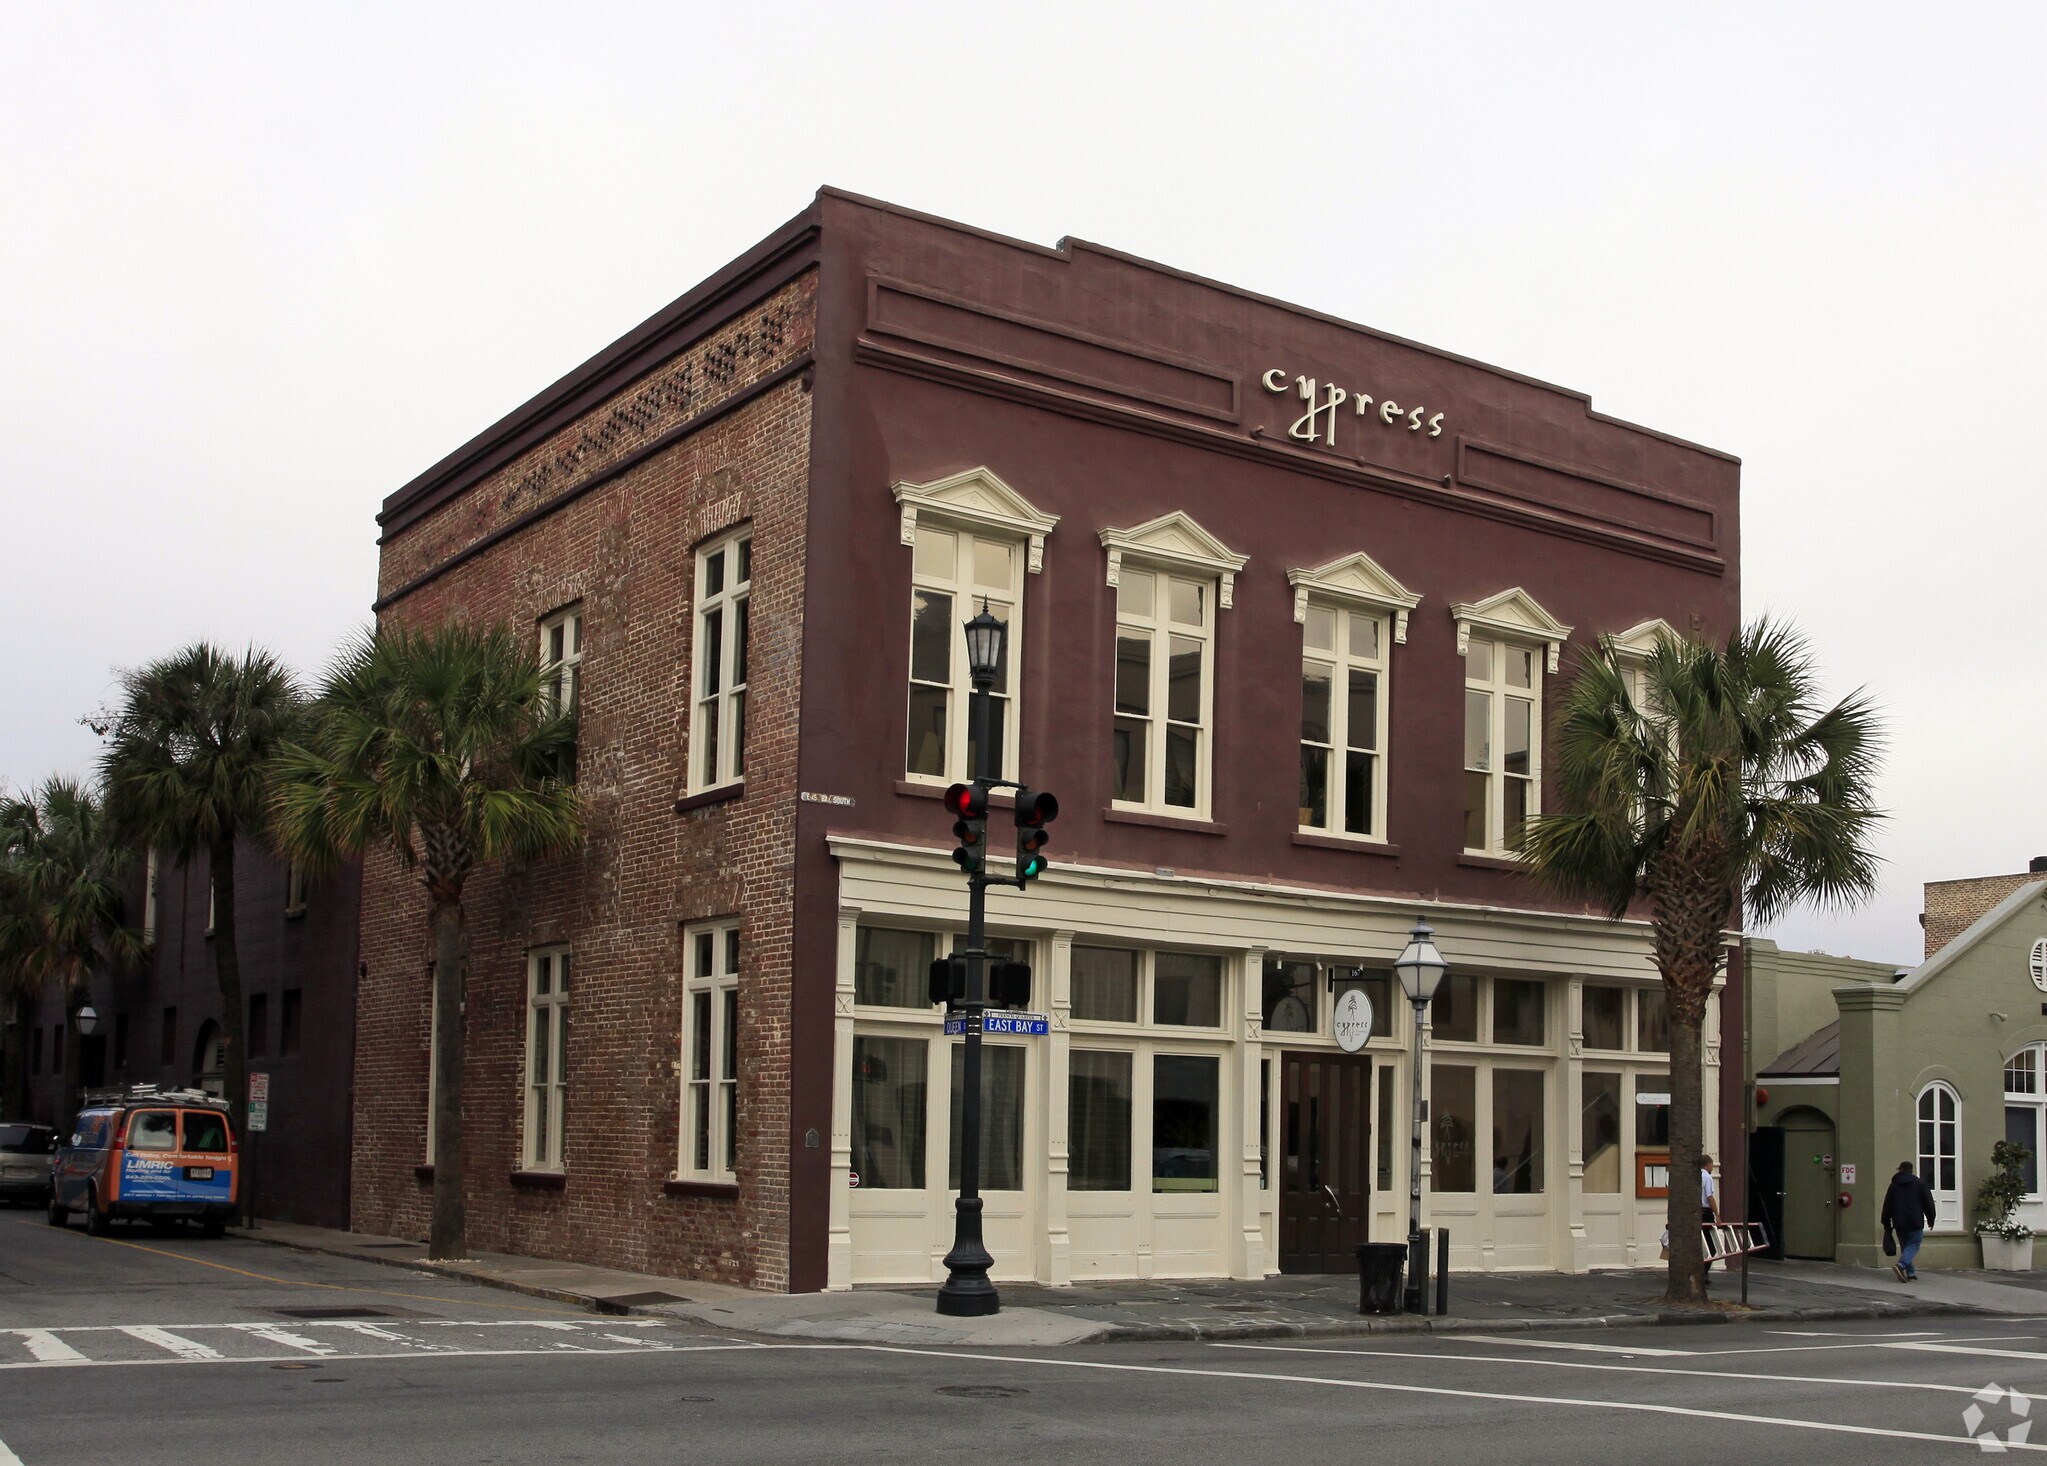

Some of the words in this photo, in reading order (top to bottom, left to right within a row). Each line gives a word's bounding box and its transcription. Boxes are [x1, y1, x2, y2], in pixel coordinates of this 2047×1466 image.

[1262, 368, 1445, 447] cypress
[989, 1019, 1012, 1031] EAST
[1015, 1020, 1033, 1033] BAY
[1036, 1024, 1044, 1032] ST
[1336, 1021, 1368, 1036] cypress
[127, 1160, 174, 1170] LIMRIC
